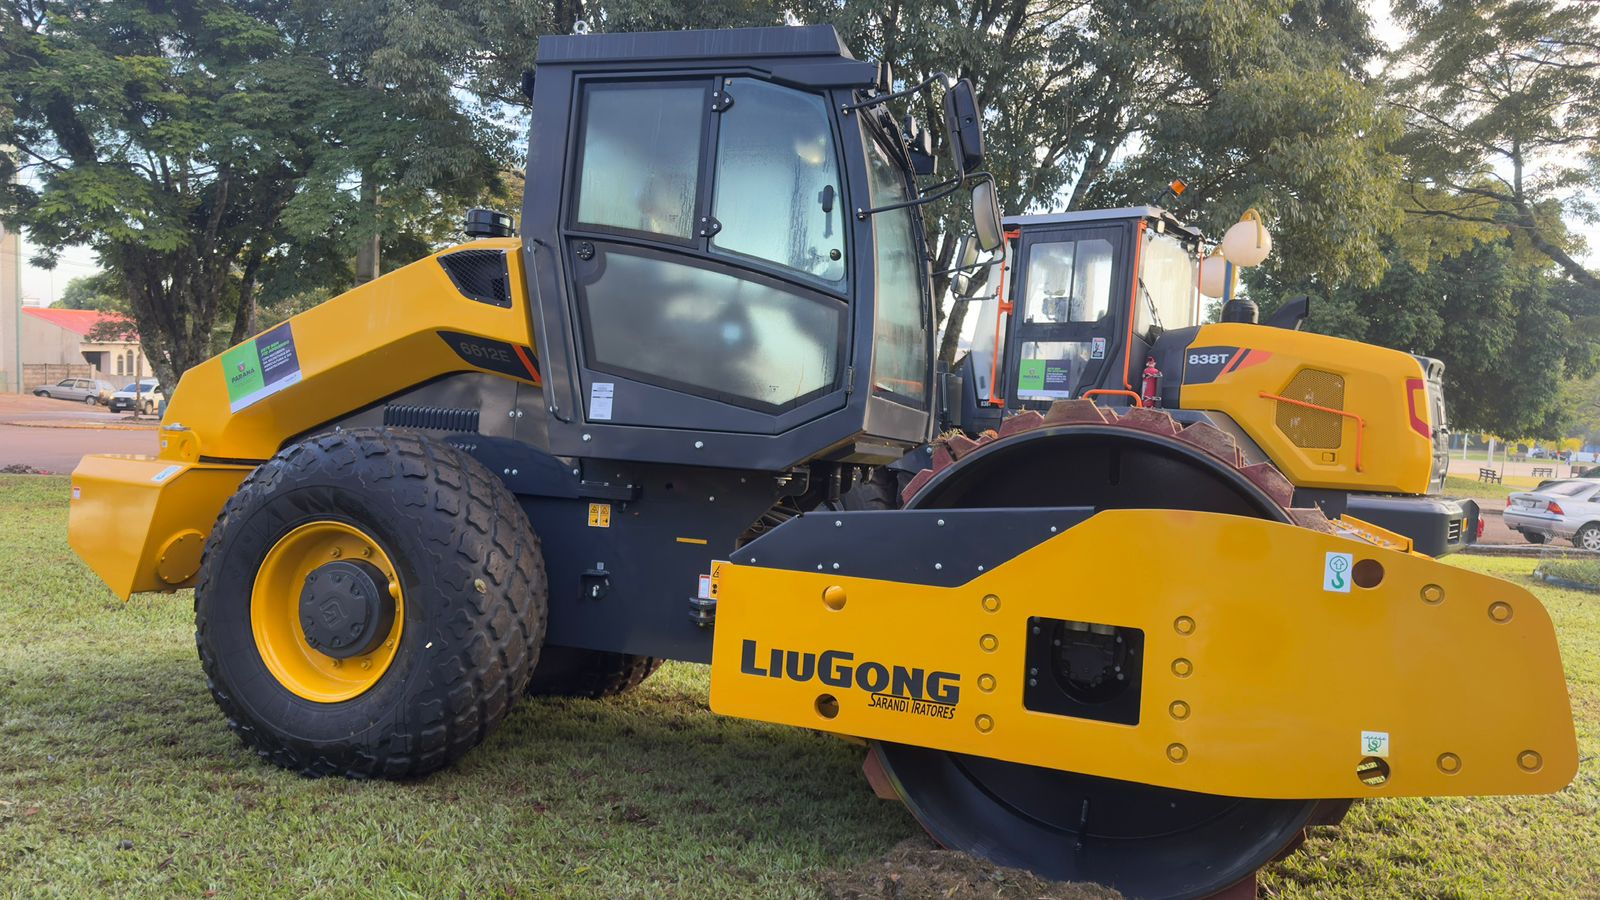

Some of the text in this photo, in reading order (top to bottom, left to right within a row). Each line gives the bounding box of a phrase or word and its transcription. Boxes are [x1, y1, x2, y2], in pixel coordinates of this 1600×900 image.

[460, 342, 511, 362] 6612E
[1189, 354, 1229, 364] 838T
[868, 693, 956, 719] SARANDI TRATORES
